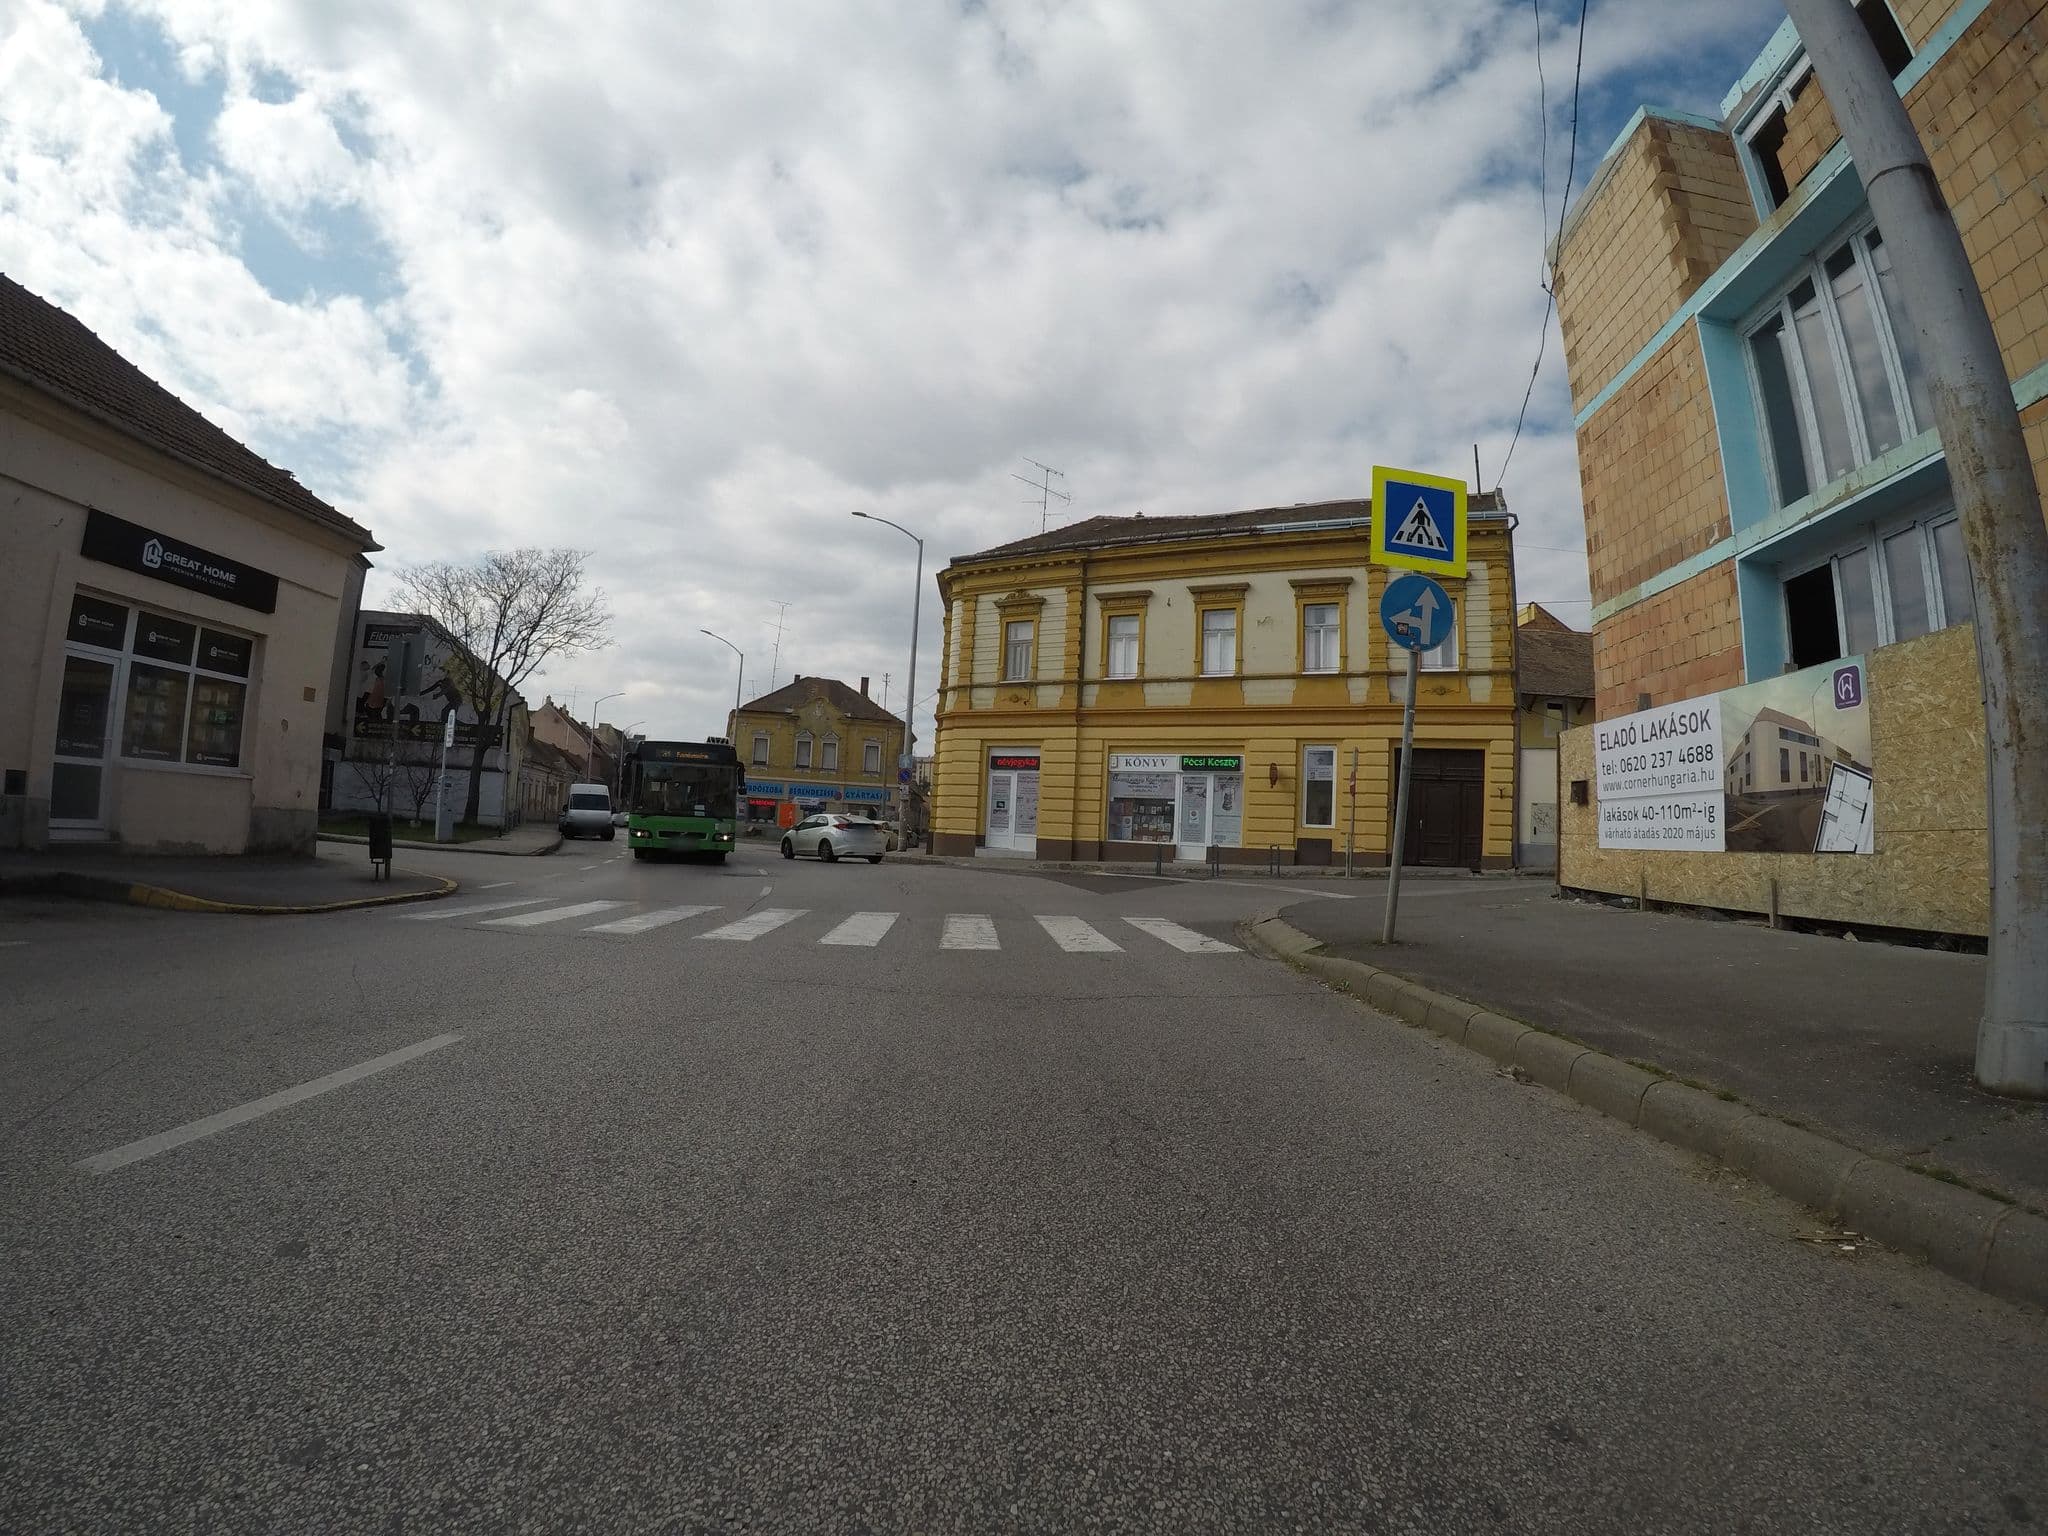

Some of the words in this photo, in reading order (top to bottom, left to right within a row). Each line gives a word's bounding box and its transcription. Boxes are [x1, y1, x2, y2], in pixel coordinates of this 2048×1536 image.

[164, 551, 201, 571] GREAT
[203, 564, 237, 583] HOME
[1600, 721, 1637, 751] ELADÓ
[1641, 708, 1712, 743] LAKÁSOK
[1125, 757, 1168, 768] KÖNYV
[1183, 757, 1206, 766] Pécsi
[1602, 760, 1618, 776] tel:
[1620, 754, 1647, 773] 0620
[1650, 750, 1673, 769] 237
[1678, 743, 1714, 764] 4688
[1602, 767, 1715, 792] www.cornerhungaria.hu
[1603, 806, 1639, 822] lakások
[1604, 826, 1632, 839] várható
[1633, 826, 1660, 839] átadás
[1662, 827, 1684, 839] 2020
[1686, 825, 1716, 842] május
